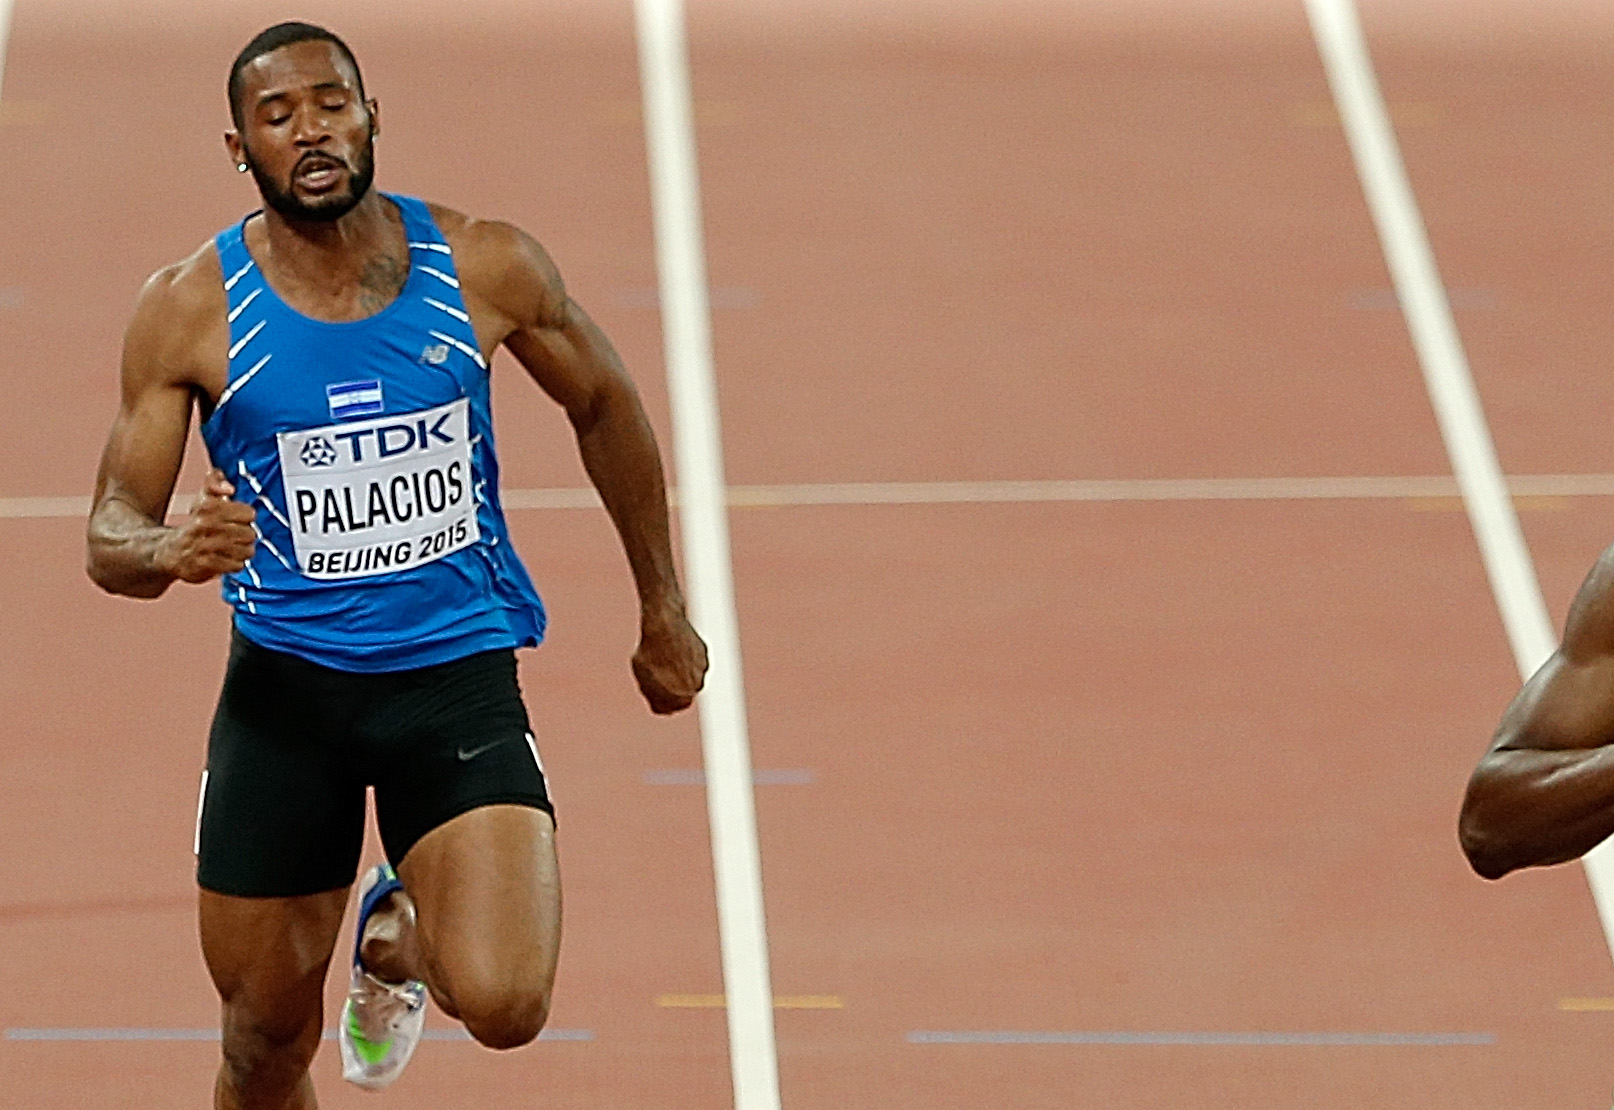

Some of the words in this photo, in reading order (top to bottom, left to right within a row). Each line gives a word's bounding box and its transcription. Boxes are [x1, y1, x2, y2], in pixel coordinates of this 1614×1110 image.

[335, 413, 455, 462] TDK
[296, 461, 463, 534] PALACIOS
[307, 545, 412, 574] BEIJING
[418, 519, 468, 559] 2015
